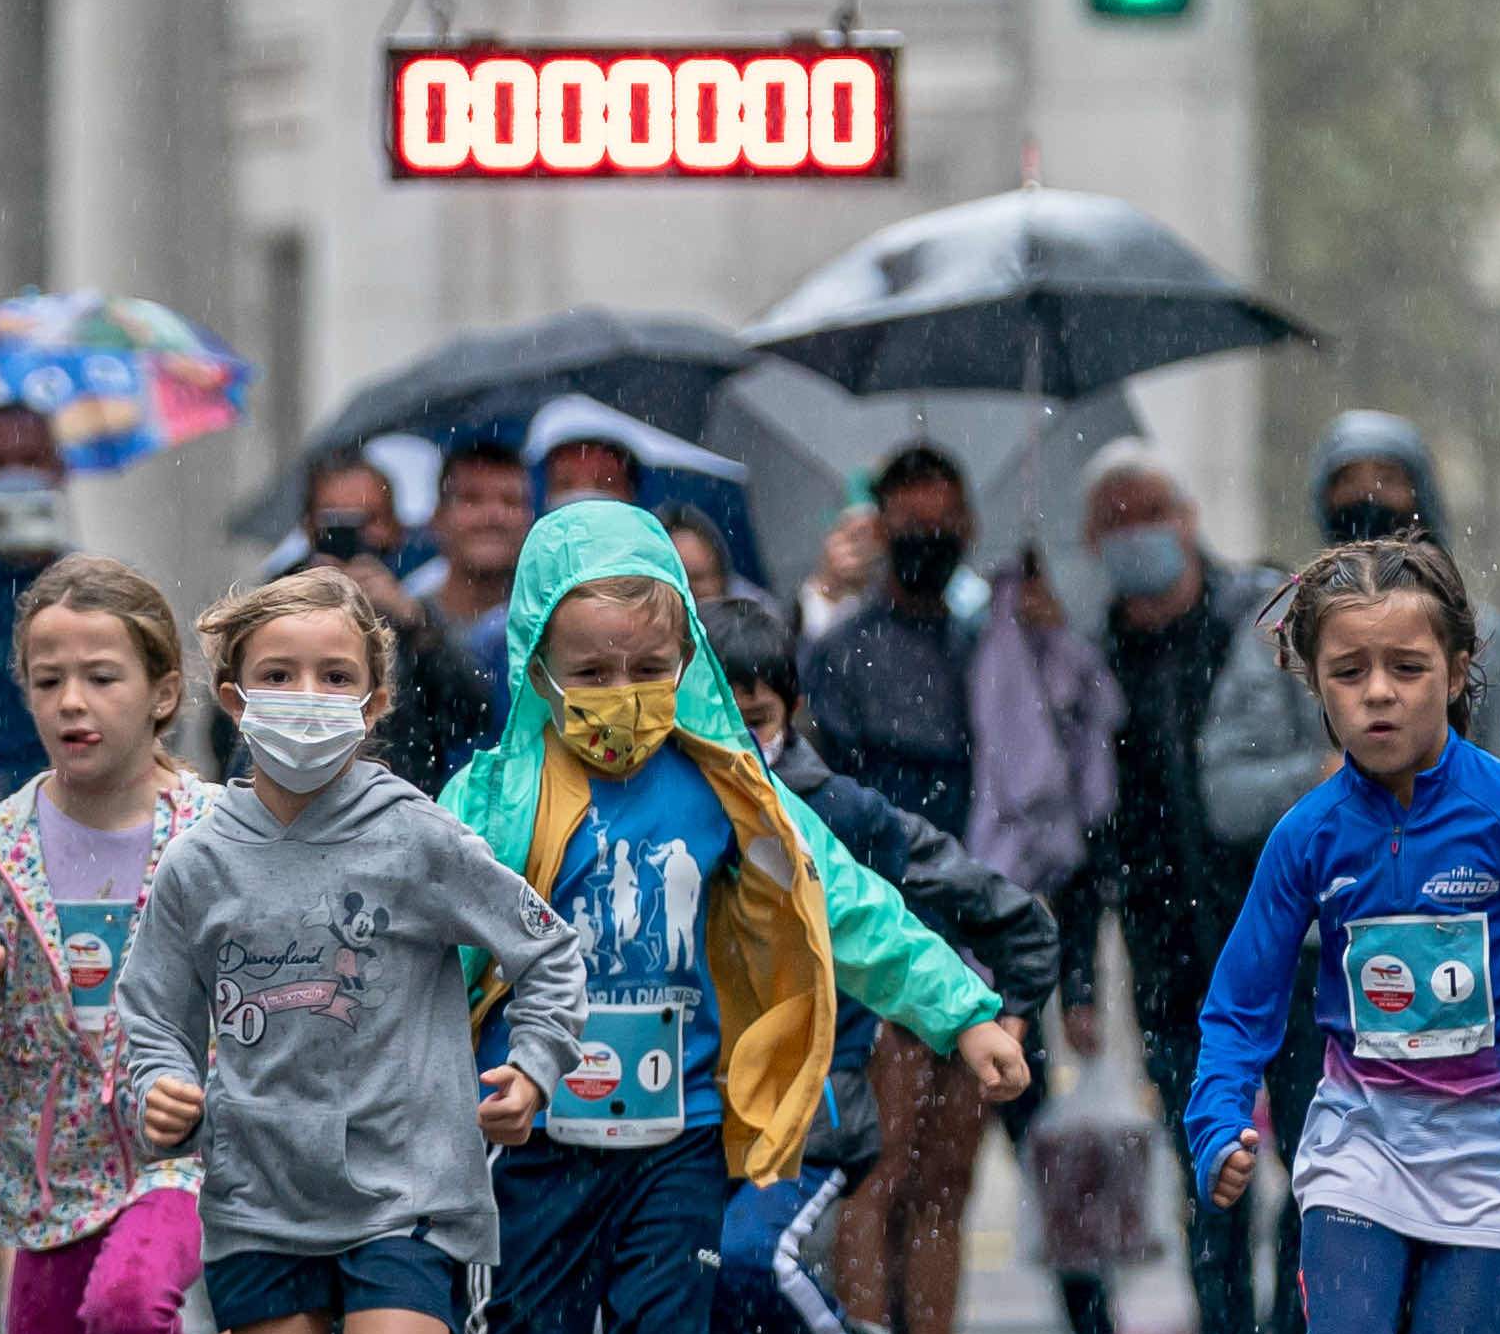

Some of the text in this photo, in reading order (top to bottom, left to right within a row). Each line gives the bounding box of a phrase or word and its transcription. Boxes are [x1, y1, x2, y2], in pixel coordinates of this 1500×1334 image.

[402, 56, 877, 169] 0000000
[1422, 880, 1499, 895] CRONOS
[217, 939, 325, 980] Disneyland
[1443, 967, 1458, 998] 1
[215, 977, 267, 1048] 20
[649, 1054, 659, 1086] 1
